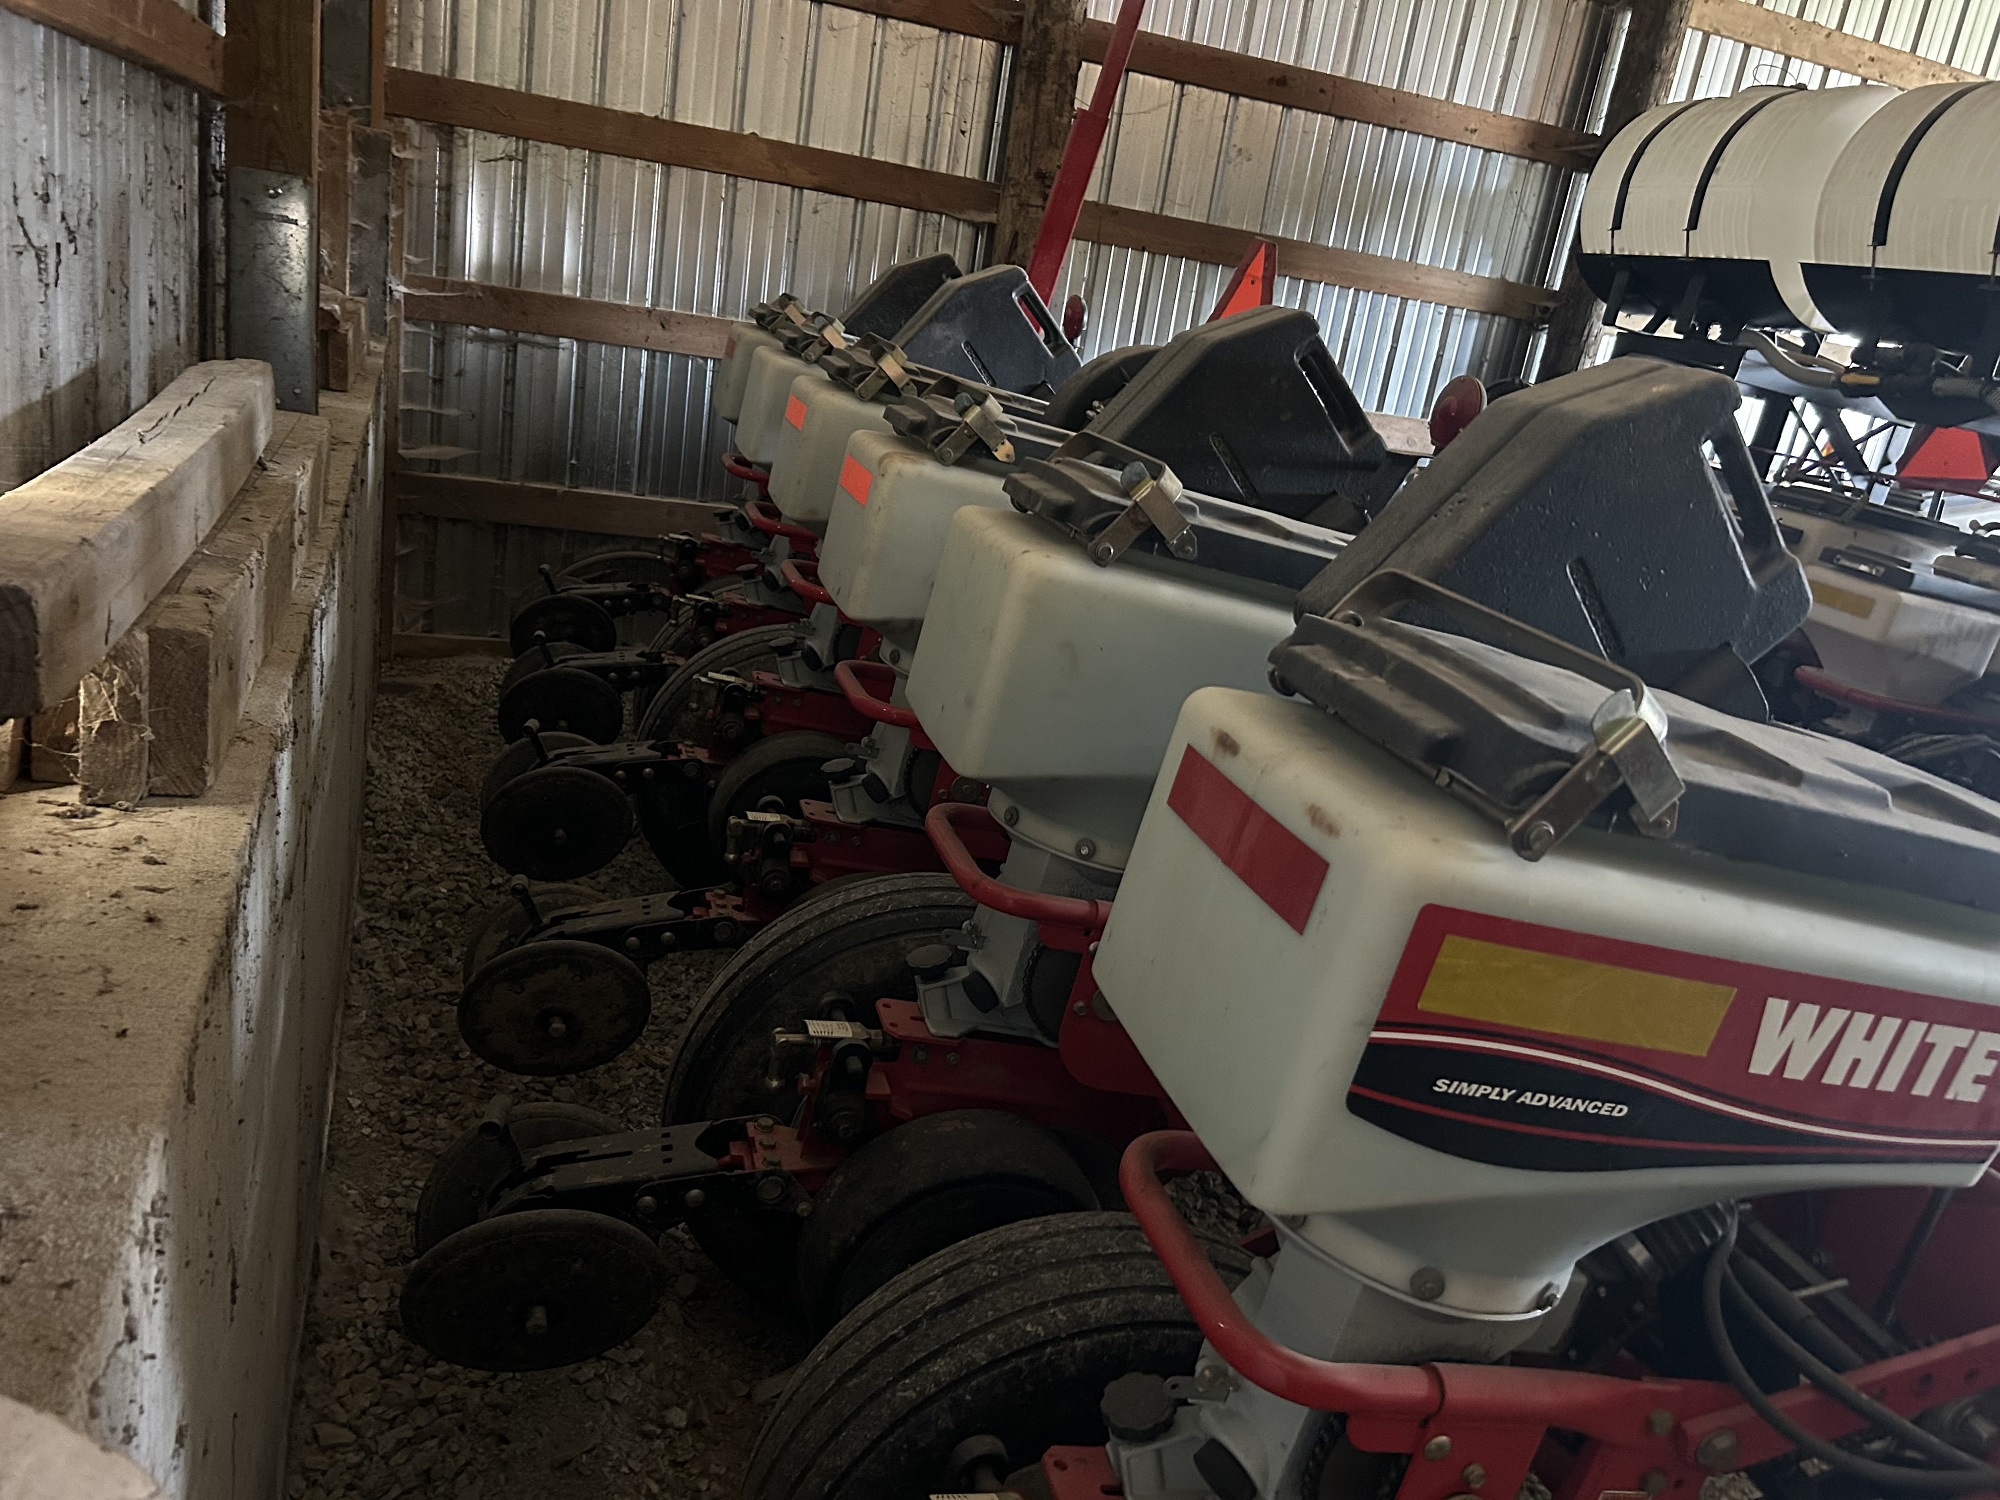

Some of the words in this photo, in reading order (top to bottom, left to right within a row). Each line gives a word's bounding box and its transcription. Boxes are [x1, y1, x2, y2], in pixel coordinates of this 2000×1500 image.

[1748, 997, 2000, 1103] WHITE
[1432, 1078, 1517, 1102] SIMPLY
[1516, 1091, 1629, 1117] ADVANCED
